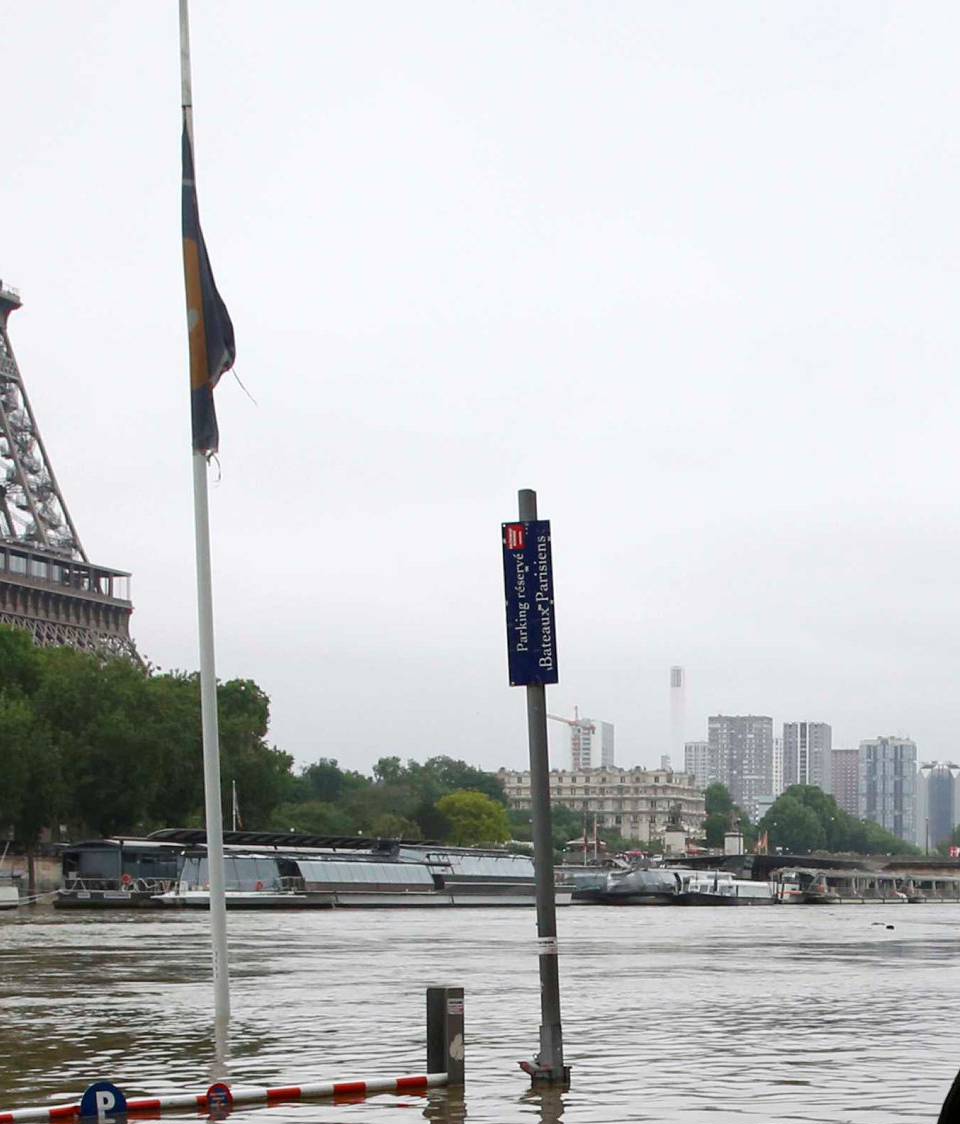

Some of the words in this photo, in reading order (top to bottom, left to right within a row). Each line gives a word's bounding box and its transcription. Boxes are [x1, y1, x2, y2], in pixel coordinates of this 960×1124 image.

[513, 553, 526, 599] réservé
[533, 535, 550, 602] Parisiens
[515, 602, 529, 652] Parking
[537, 607, 553, 667] Bateaux
[95, 1090, 115, 1116] P
